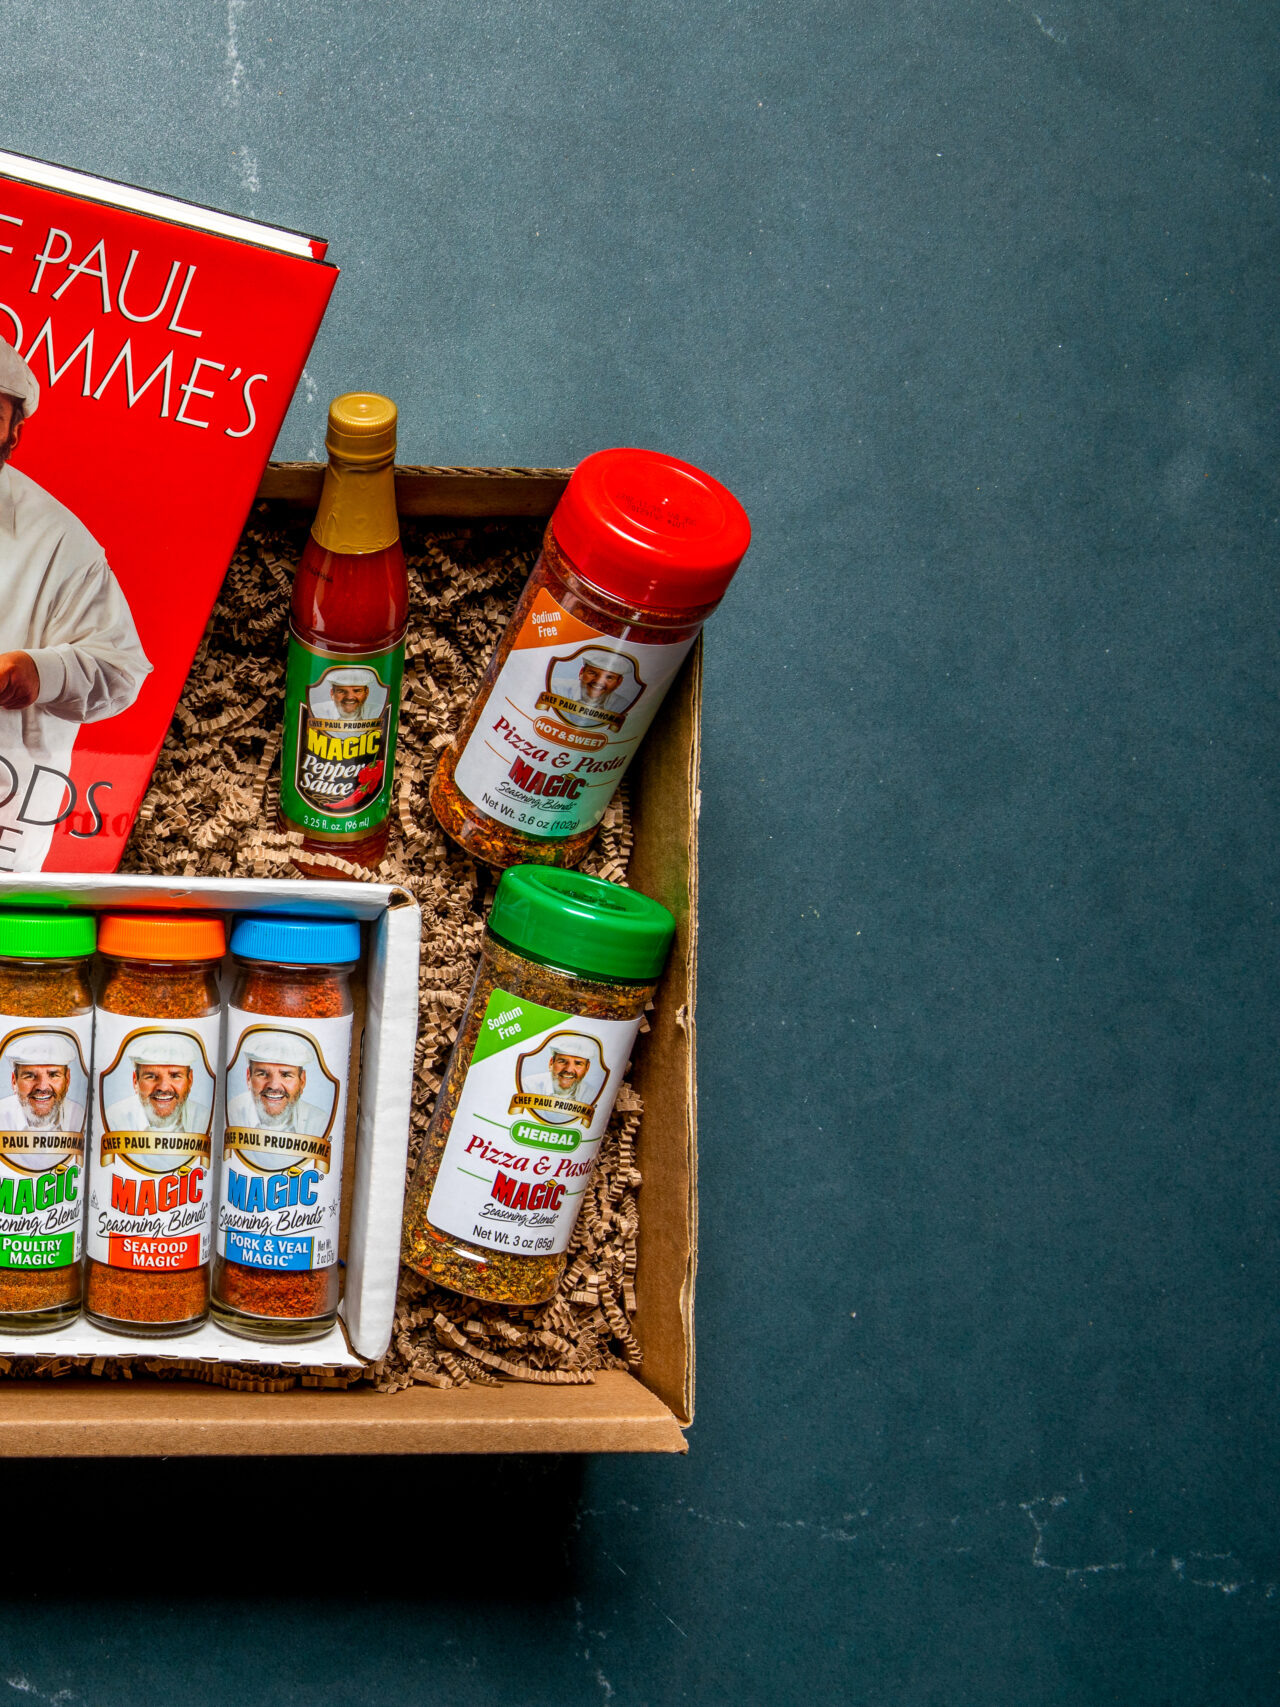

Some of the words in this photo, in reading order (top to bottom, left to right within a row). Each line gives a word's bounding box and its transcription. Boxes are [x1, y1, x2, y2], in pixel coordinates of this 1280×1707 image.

[29, 227, 203, 337] PAUL
[532, 611, 561, 624] Sodium
[538, 625, 558, 638] Free
[558, 700, 577, 711] PAUL
[324, 721, 341, 729] PAUL
[307, 727, 381, 761] MAGIC
[492, 715, 550, 762] Pizza
[551, 752, 573, 769] &
[571, 755, 628, 774] Pasta
[302, 754, 366, 782] Pepper
[300, 772, 354, 796] Sauce
[482, 792, 499, 810] Net
[500, 805, 516, 820] Wt.
[518, 813, 534, 825] 3.6
[536, 820, 550, 829] oz
[304, 815, 320, 828] 3.25
[331, 823, 343, 831] oz.
[487, 1006, 523, 1030] Sodium
[497, 1022, 522, 1040] Free
[513, 1096, 531, 1105] CHEF
[533, 1098, 552, 1107] PAUL
[2, 1136, 29, 1148] PAUL
[103, 1137, 121, 1150] CHEF
[124, 1137, 151, 1149] PAUL
[239, 1132, 261, 1146] PAUL
[264, 1136, 330, 1158] PRUDHOMME
[517, 1125, 575, 1146] HERBAL
[464, 1134, 531, 1172] Pizza
[532, 1156, 551, 1175] &
[98, 1212, 163, 1240] Seasoning
[2, 1238, 62, 1252] POULTRY
[123, 1238, 188, 1254] SEAFOOD
[230, 1232, 260, 1251] PORK
[263, 1239, 274, 1252] &
[278, 1240, 308, 1253] VEAL
[472, 1225, 491, 1240] Net
[494, 1230, 510, 1245] Wt.
[513, 1235, 520, 1247] 3
[521, 1239, 534, 1249] oz
